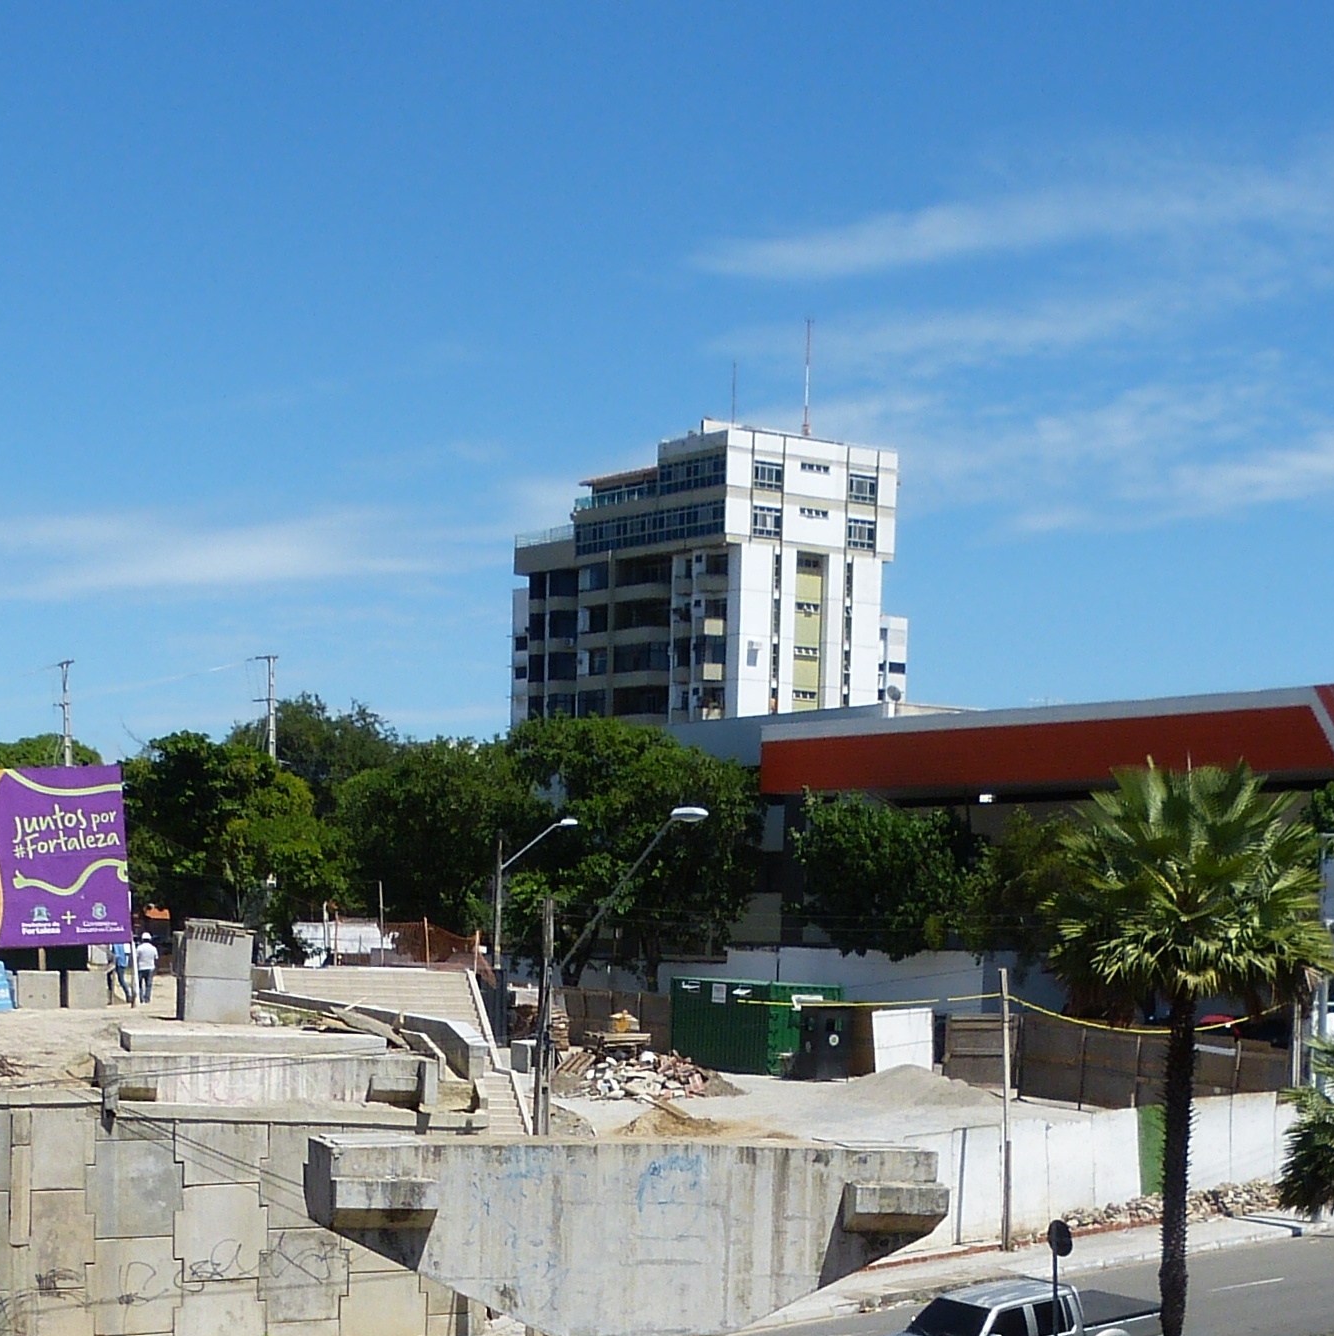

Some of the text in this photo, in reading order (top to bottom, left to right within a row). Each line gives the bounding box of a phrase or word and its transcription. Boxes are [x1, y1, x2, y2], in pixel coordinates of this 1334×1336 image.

[12, 803, 117, 843] Juntos por
[12, 829, 121, 859] #Fortaleza
